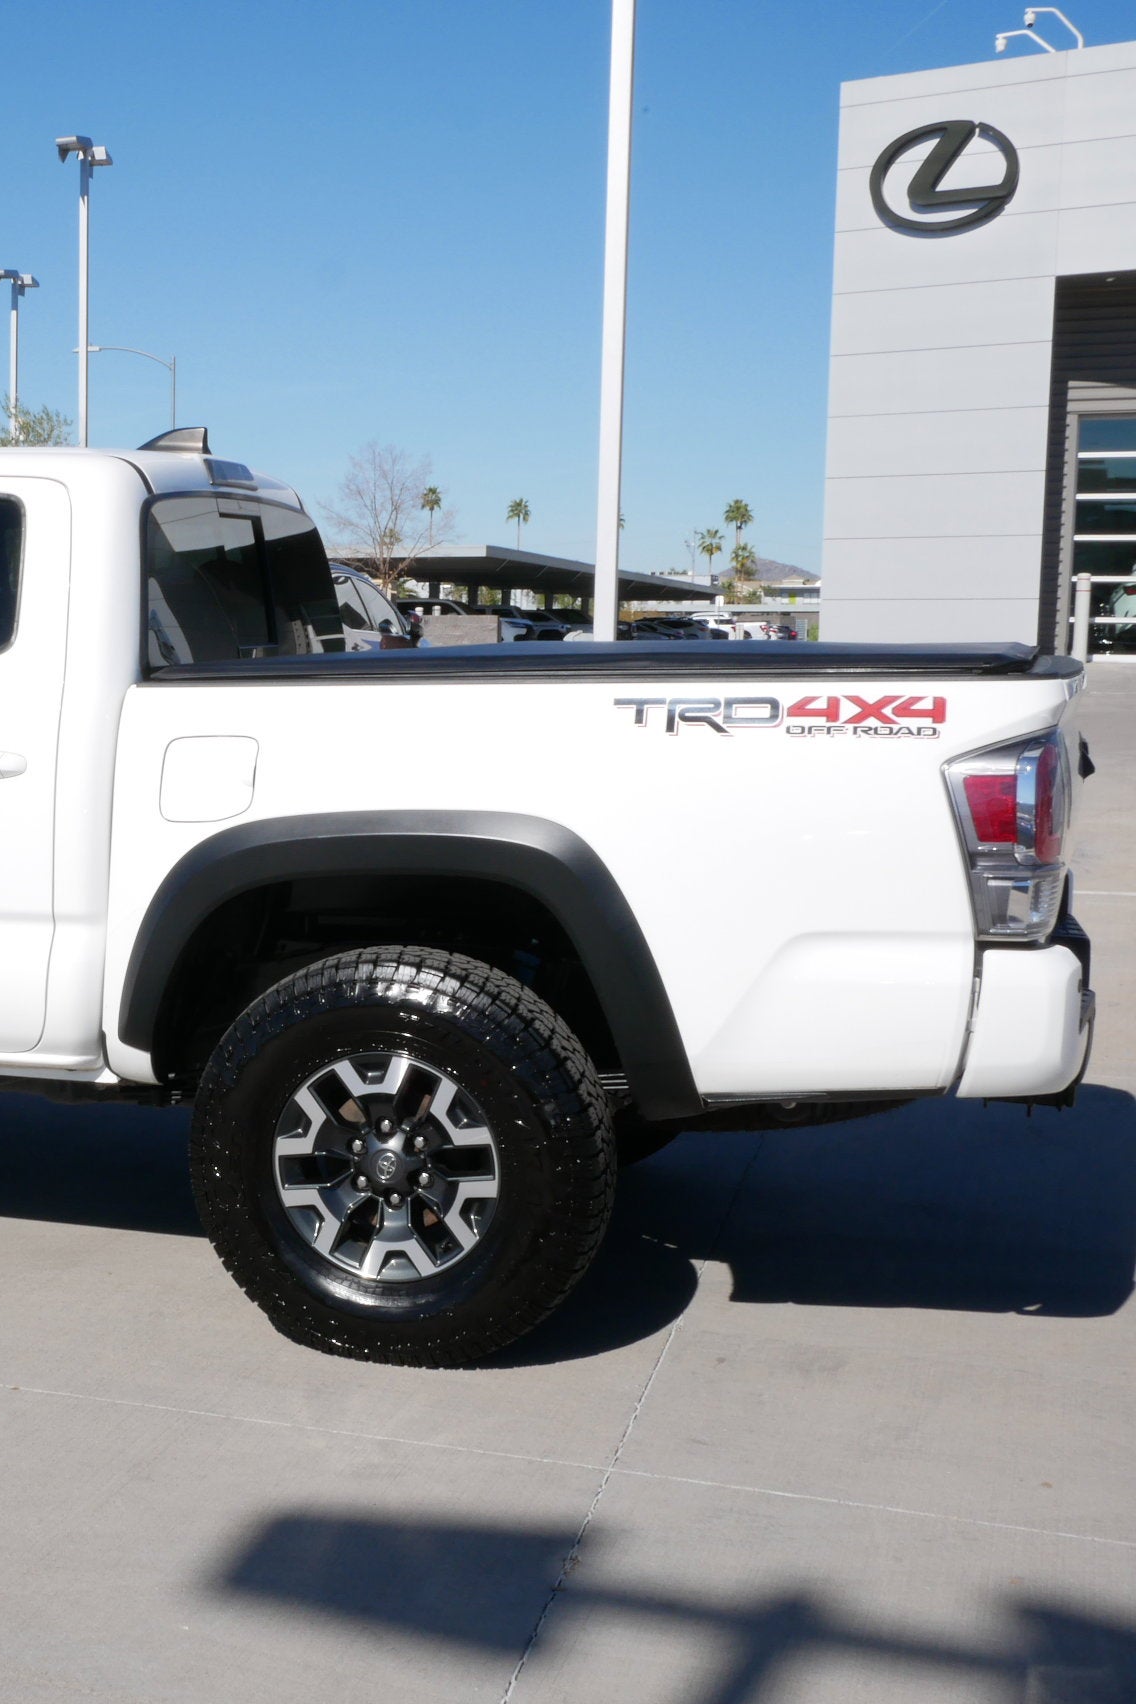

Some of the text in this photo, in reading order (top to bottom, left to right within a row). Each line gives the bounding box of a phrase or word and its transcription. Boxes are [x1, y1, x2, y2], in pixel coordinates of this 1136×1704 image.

[614, 697, 783, 735] TRD
[786, 725, 940, 738] OFF ROAD
